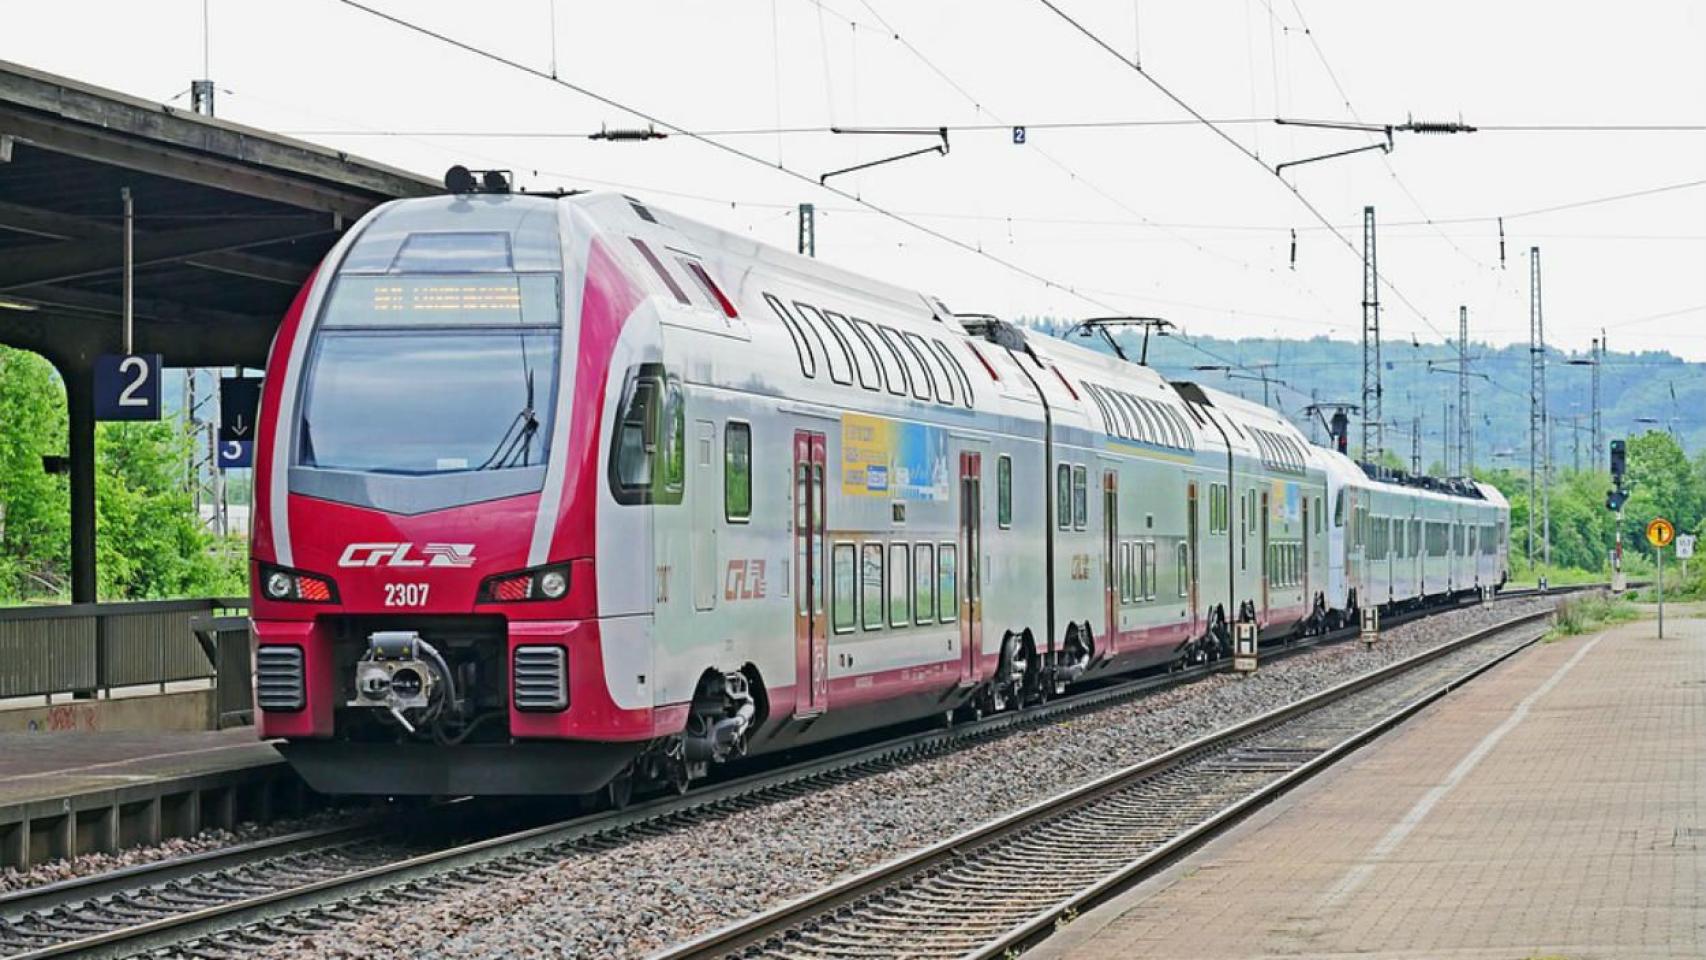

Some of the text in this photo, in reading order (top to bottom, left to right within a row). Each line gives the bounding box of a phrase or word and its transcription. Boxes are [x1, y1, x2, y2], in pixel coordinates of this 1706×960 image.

[1016, 129, 1023, 141] 2
[118, 356, 149, 406] 2
[338, 542, 425, 568] CFL
[384, 583, 430, 606] 2307
[1237, 626, 1254, 653] H
